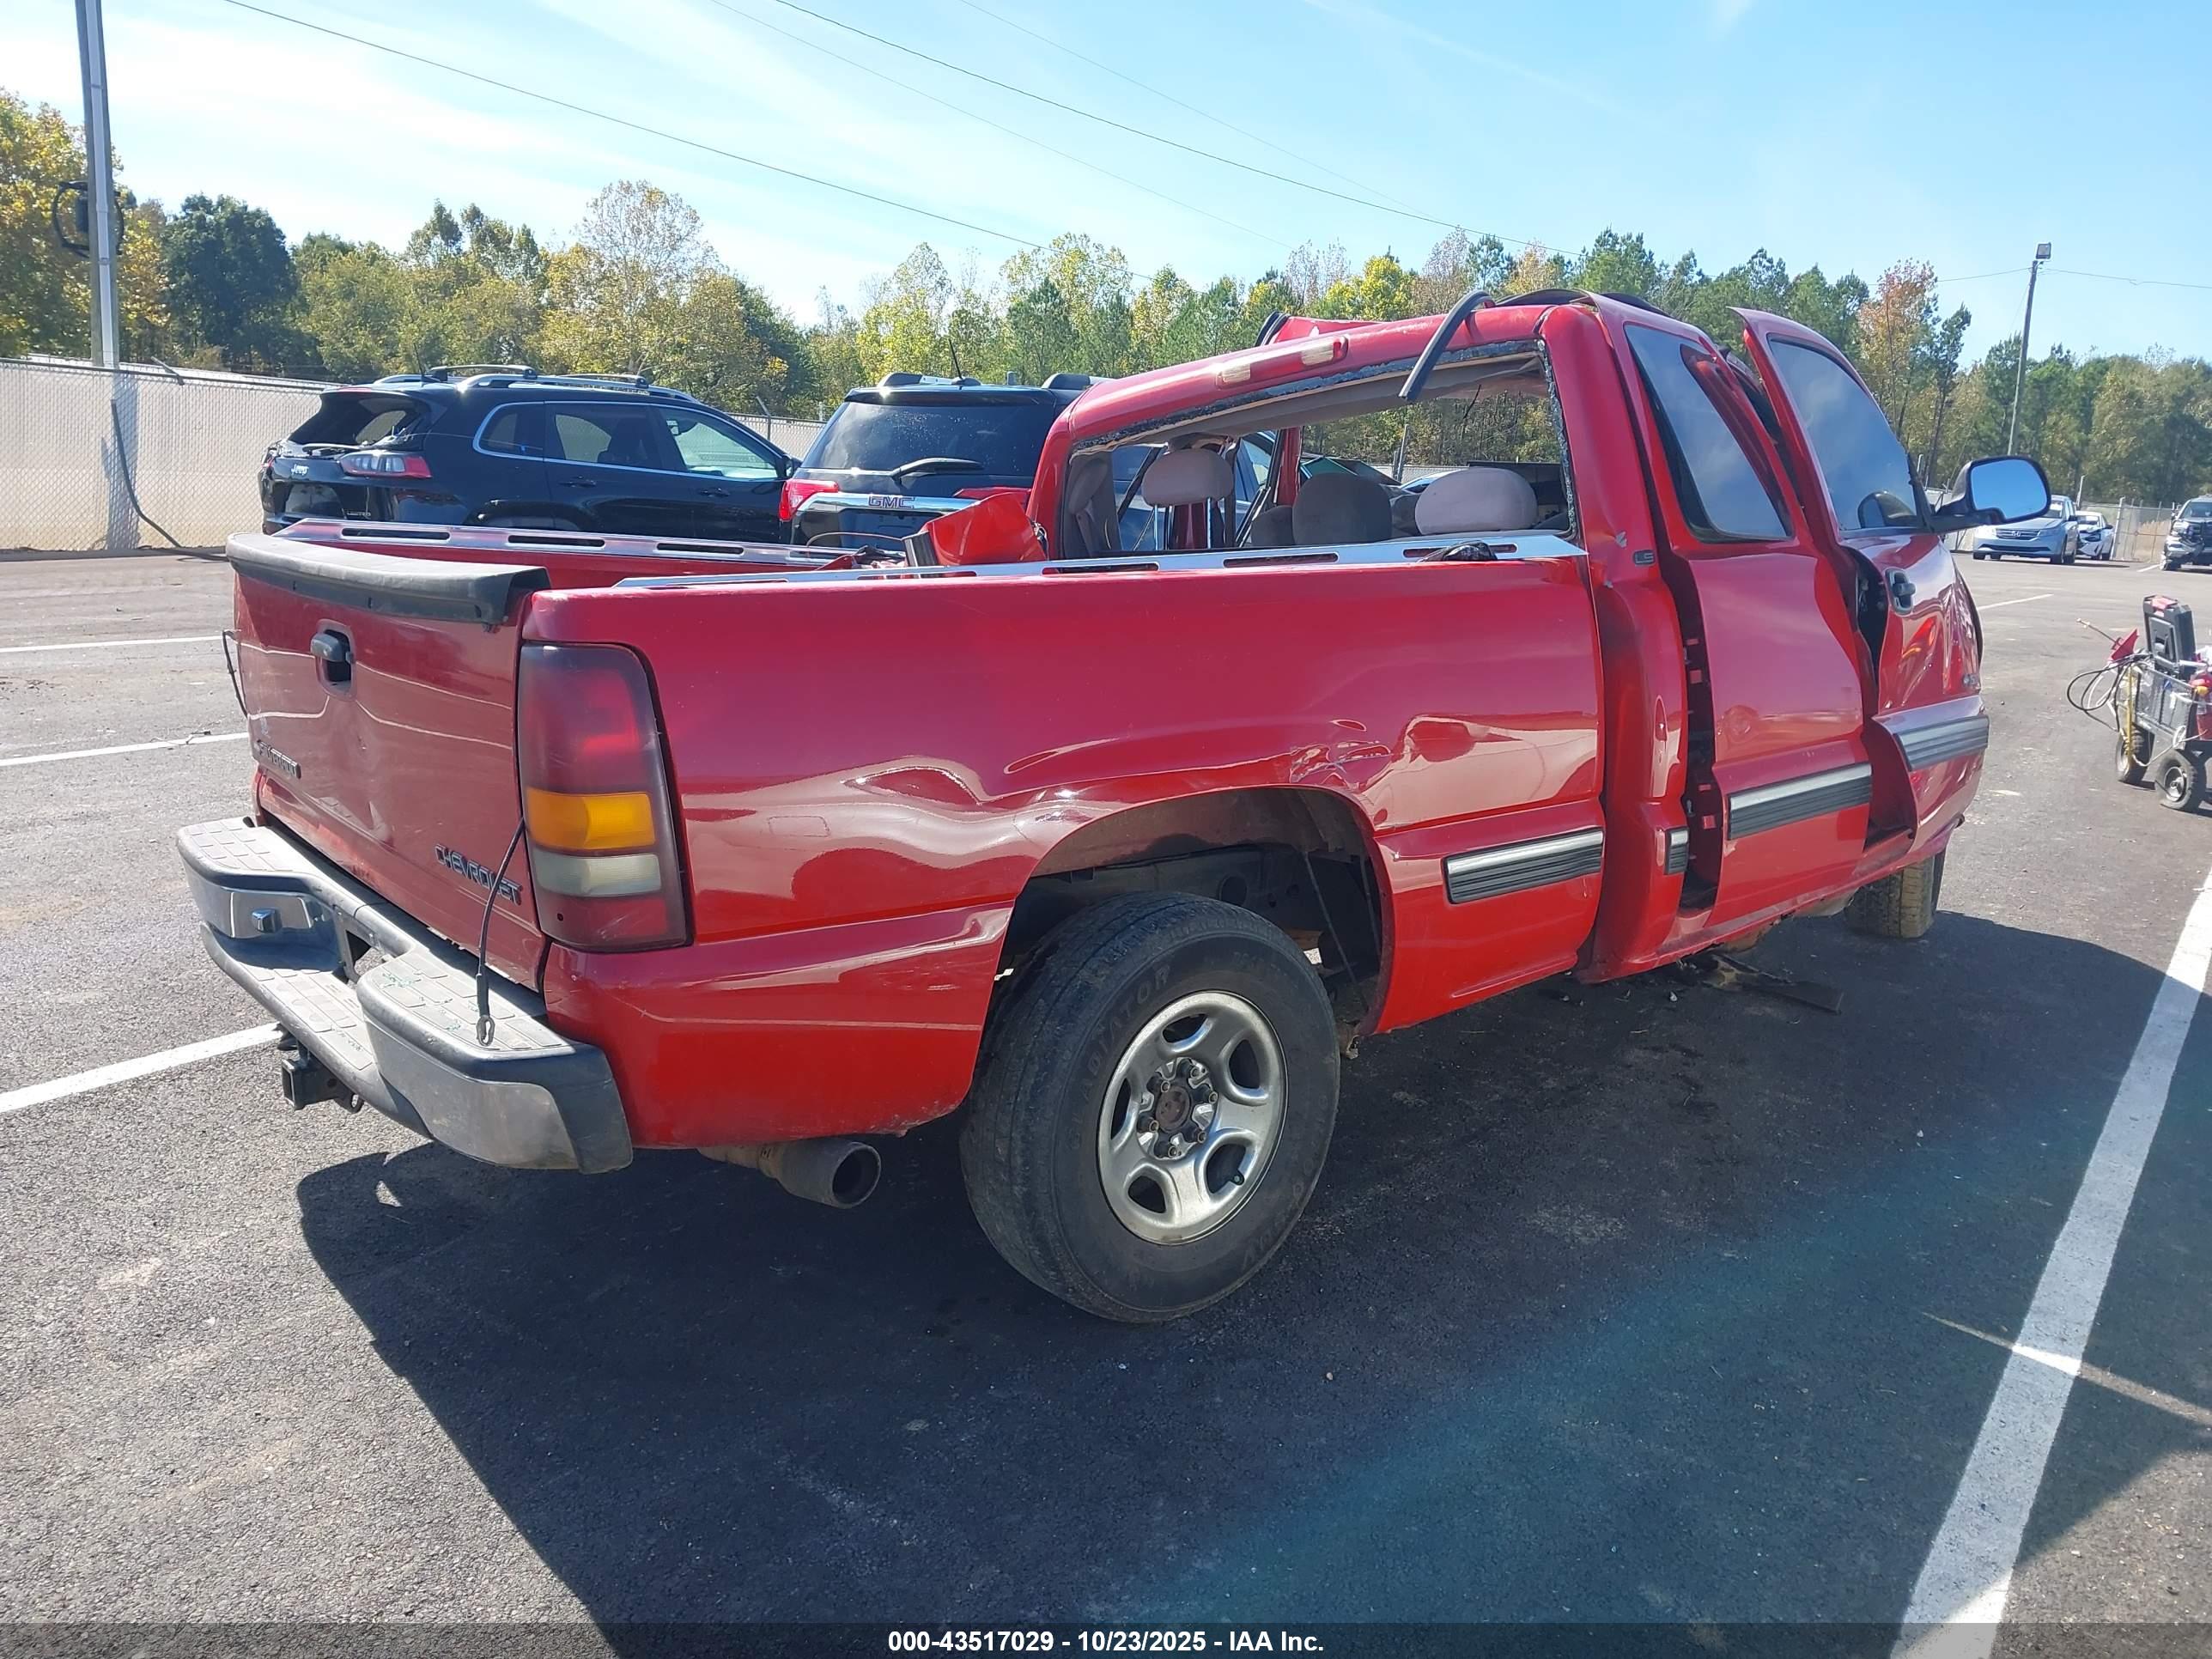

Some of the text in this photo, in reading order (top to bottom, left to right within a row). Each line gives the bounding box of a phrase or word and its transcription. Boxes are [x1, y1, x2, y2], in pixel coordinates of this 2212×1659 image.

[291, 464, 309, 476] Jeep
[868, 495, 915, 509] GMC
[435, 844, 522, 906] CHEVROLET
